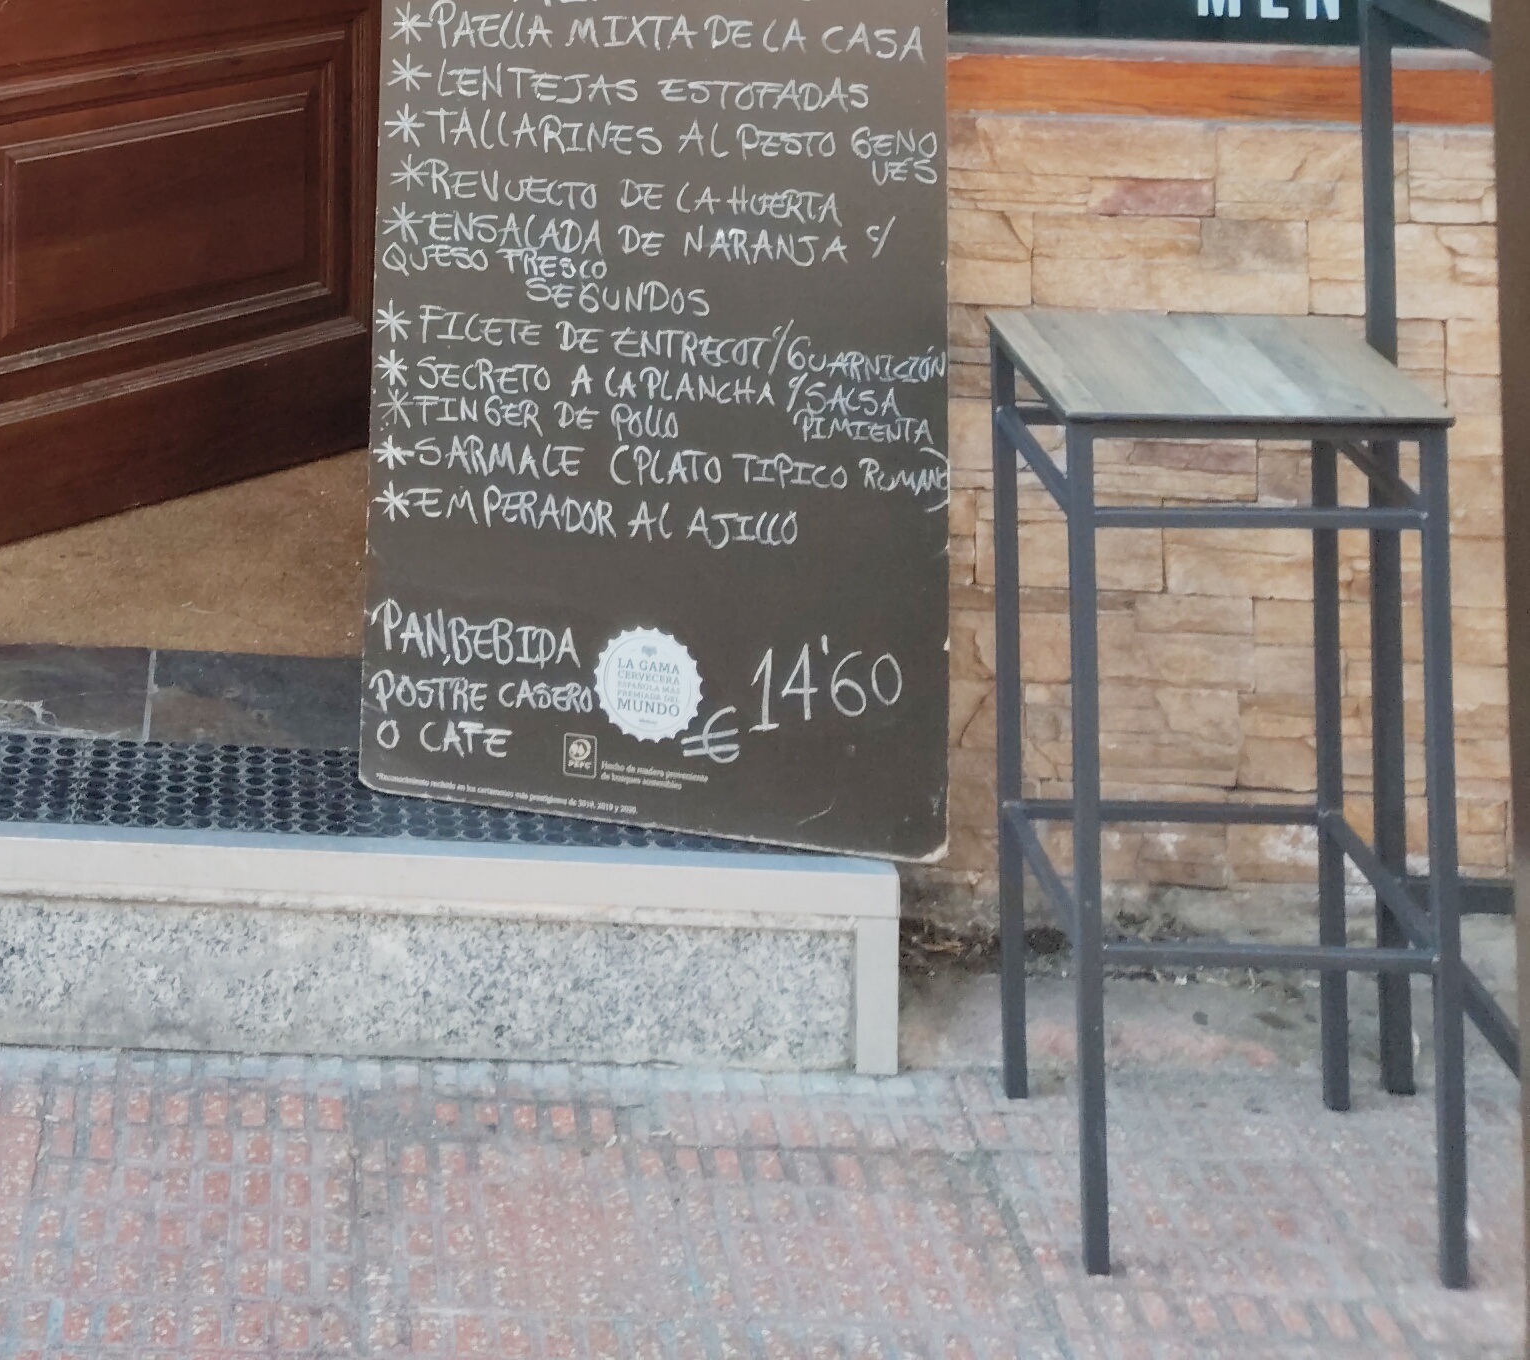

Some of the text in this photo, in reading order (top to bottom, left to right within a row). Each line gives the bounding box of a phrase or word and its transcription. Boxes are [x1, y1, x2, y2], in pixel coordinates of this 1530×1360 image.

[569, 14, 698, 51] MIXTA
[704, 14, 753, 49] DE
[821, 24, 927, 63] CASA
[437, 61, 870, 112] LENTEJAS ESTOFADAS
[423, 109, 664, 156] TALLARINES
[678, 118, 729, 158] AL
[735, 123, 837, 161] PESTO
[619, 178, 666, 211] DE
[726, 182, 841, 227] HUERTA
[381, 242, 608, 280] QUESO FRESCO
[427, 210, 604, 257] ENSALADA
[617, 227, 666, 257] DE
[682, 228, 849, 267] NARANJA
[525, 277, 711, 317] SEGUNDOS
[555, 319, 606, 356] DE
[611, 327, 772, 371] ENTRECOT
[417, 357, 552, 393] SECRETO
[570, 366, 594, 399] A
[638, 374, 777, 407] PLANCHA
[413, 394, 544, 437] FINGER
[554, 401, 601, 431] DE
[792, 407, 935, 445] PIMIENTA
[731, 452, 850, 490] TIPICO
[408, 487, 618, 541] EMPERADOR
[617, 657, 680, 676] LA GAMA
[617, 669, 680, 686] CERVECERA
[368, 669, 594, 716] POSTRE CASERO
[617, 697, 681, 717] MUNDO
[375, 719, 401, 750] O
[680, 705, 741, 764] €
